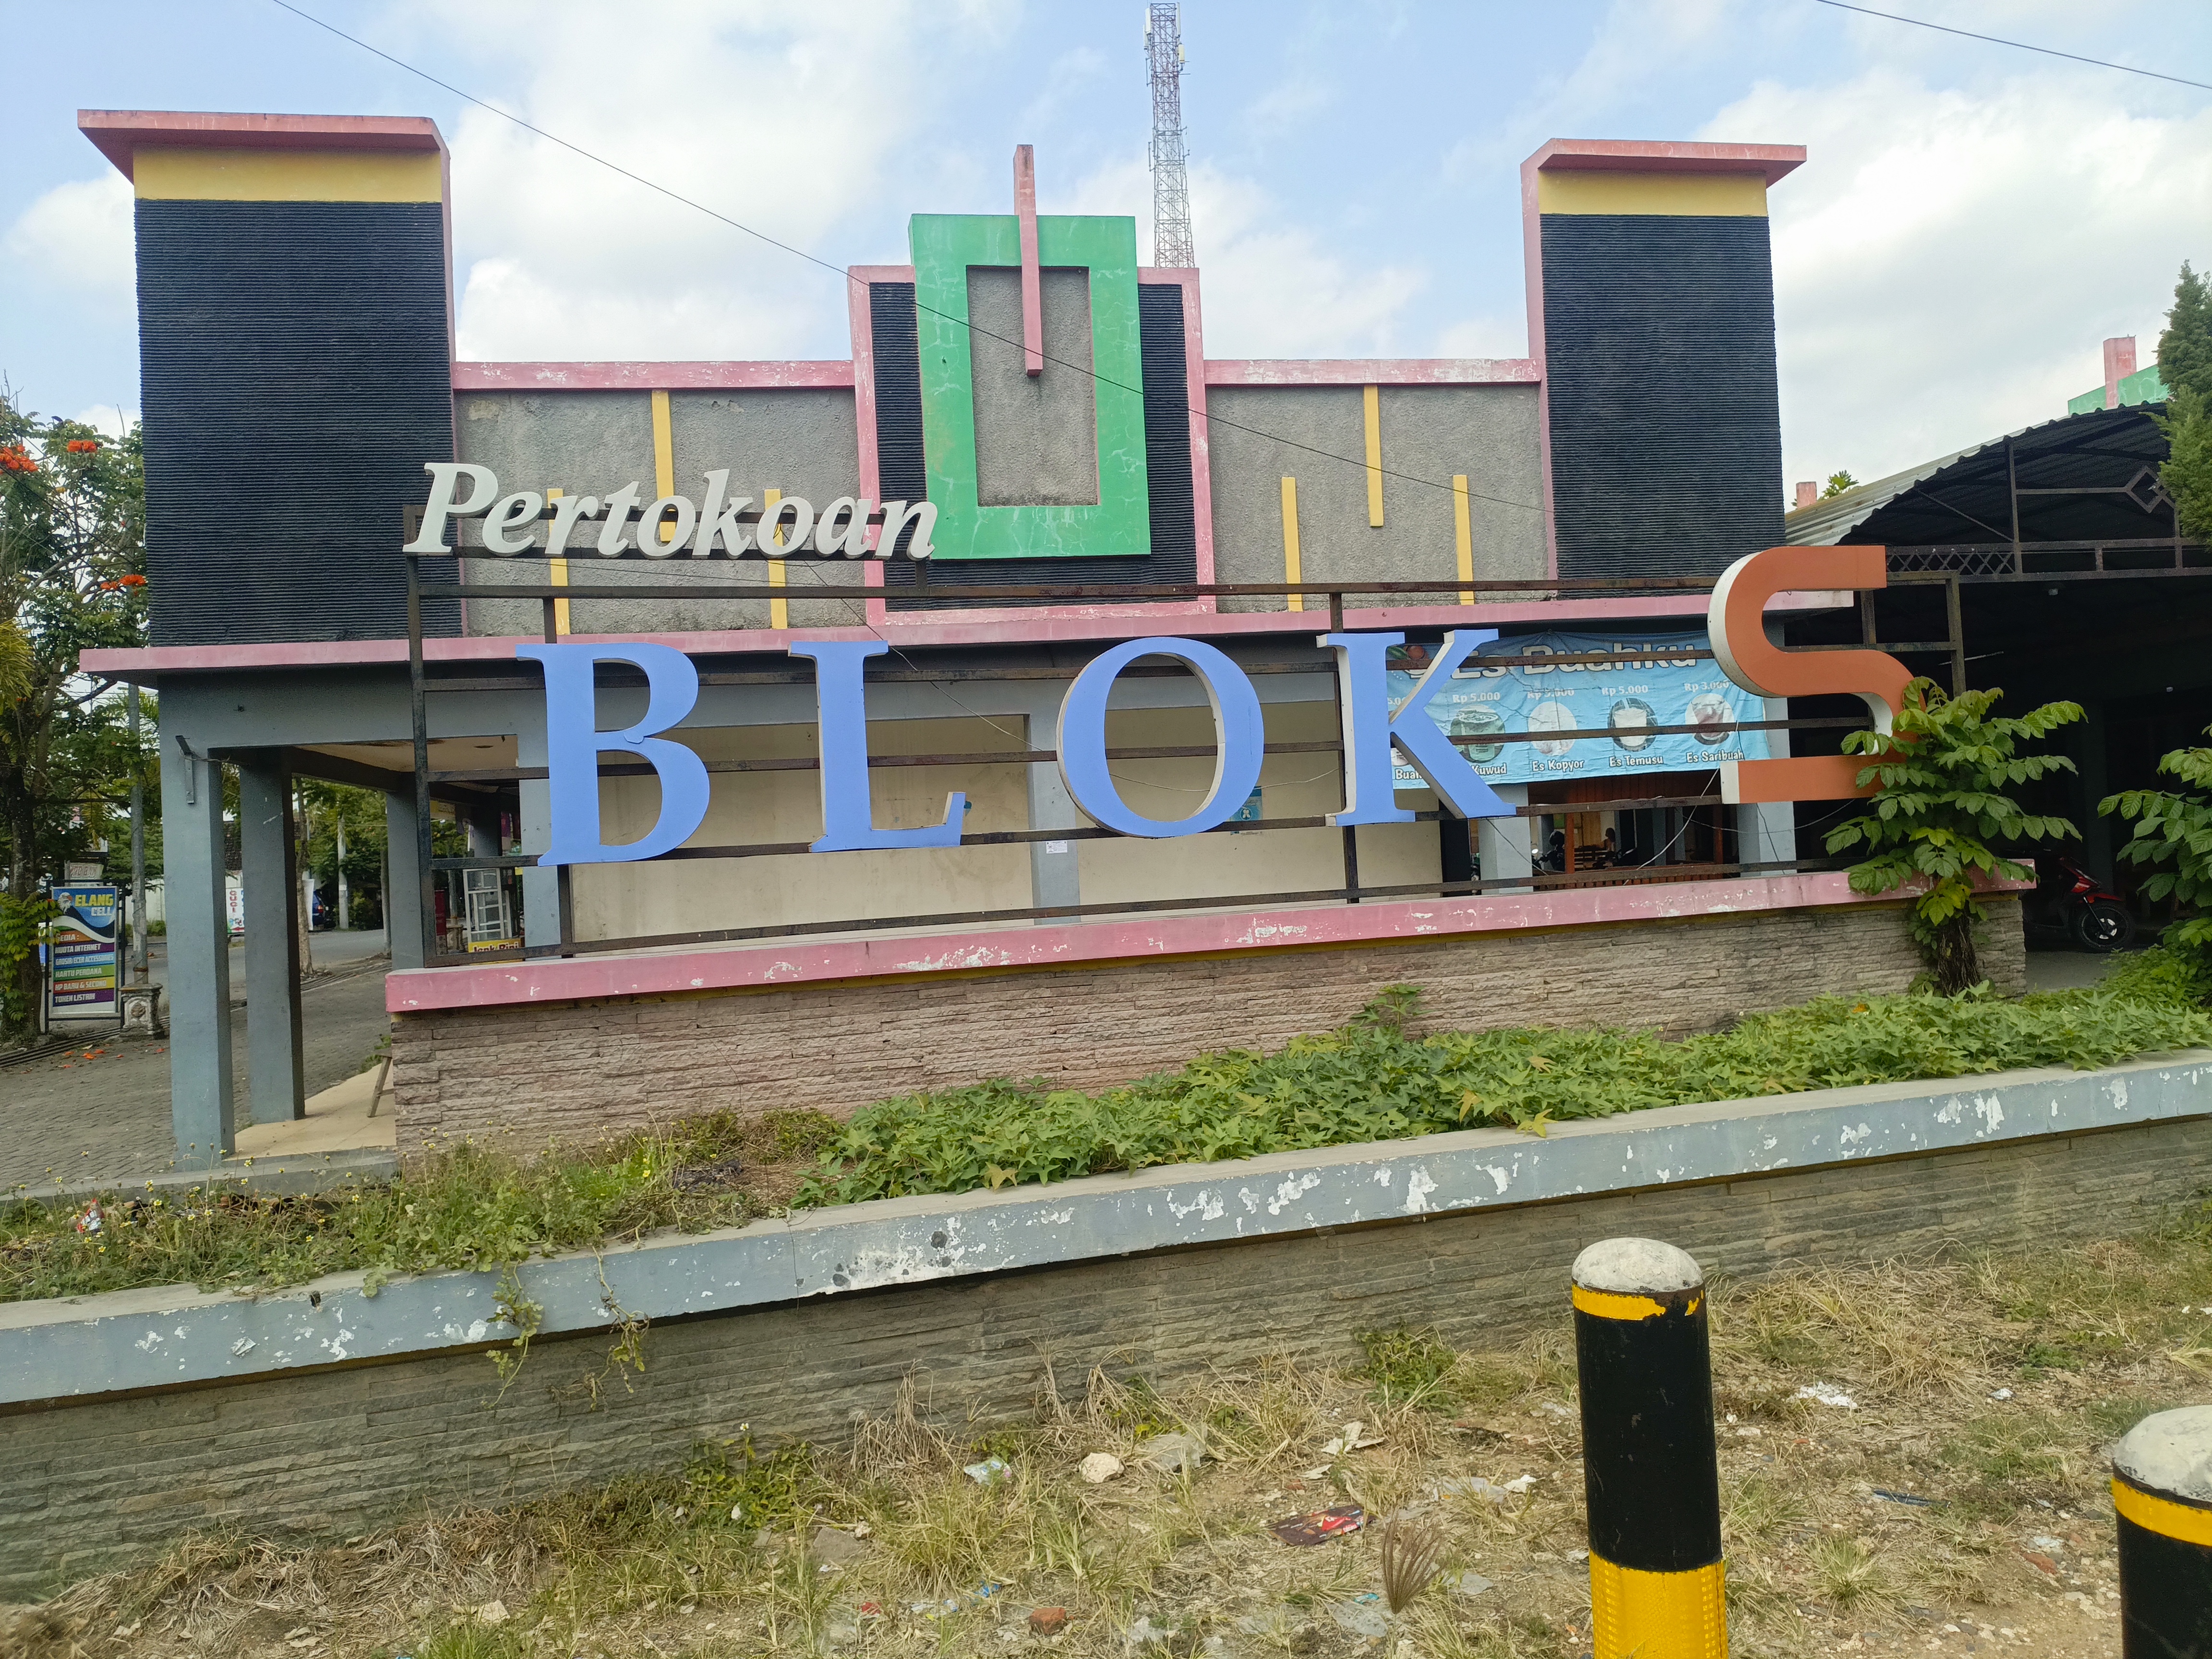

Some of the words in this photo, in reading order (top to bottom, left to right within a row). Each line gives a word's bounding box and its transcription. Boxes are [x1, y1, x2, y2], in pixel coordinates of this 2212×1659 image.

[402, 462, 937, 562] Pertokoan
[1521, 642, 1696, 674] Buahku
[1601, 687, 1616, 697] Rp
[1618, 685, 1648, 694] 5.000
[1684, 683, 1699, 692] Rp
[1452, 694, 1468, 703] Rp
[1470, 692, 1501, 701] 5.000
[515, 628, 1518, 866] BLOK
[1707, 545, 1926, 805] S
[1609, 757, 1622, 767] Es
[1624, 755, 1664, 766] Temusu
[1686, 752, 1699, 763] Es
[1701, 748, 1744, 762] Saribuah
[1532, 761, 1544, 771] Es
[1547, 758, 1585, 773] Kopyor
[74, 894, 114, 907] ELANG
[91, 907, 112, 916] CELL
[75, 968, 102, 976] PERDANA
[73, 993, 96, 1001] LISTRIK
